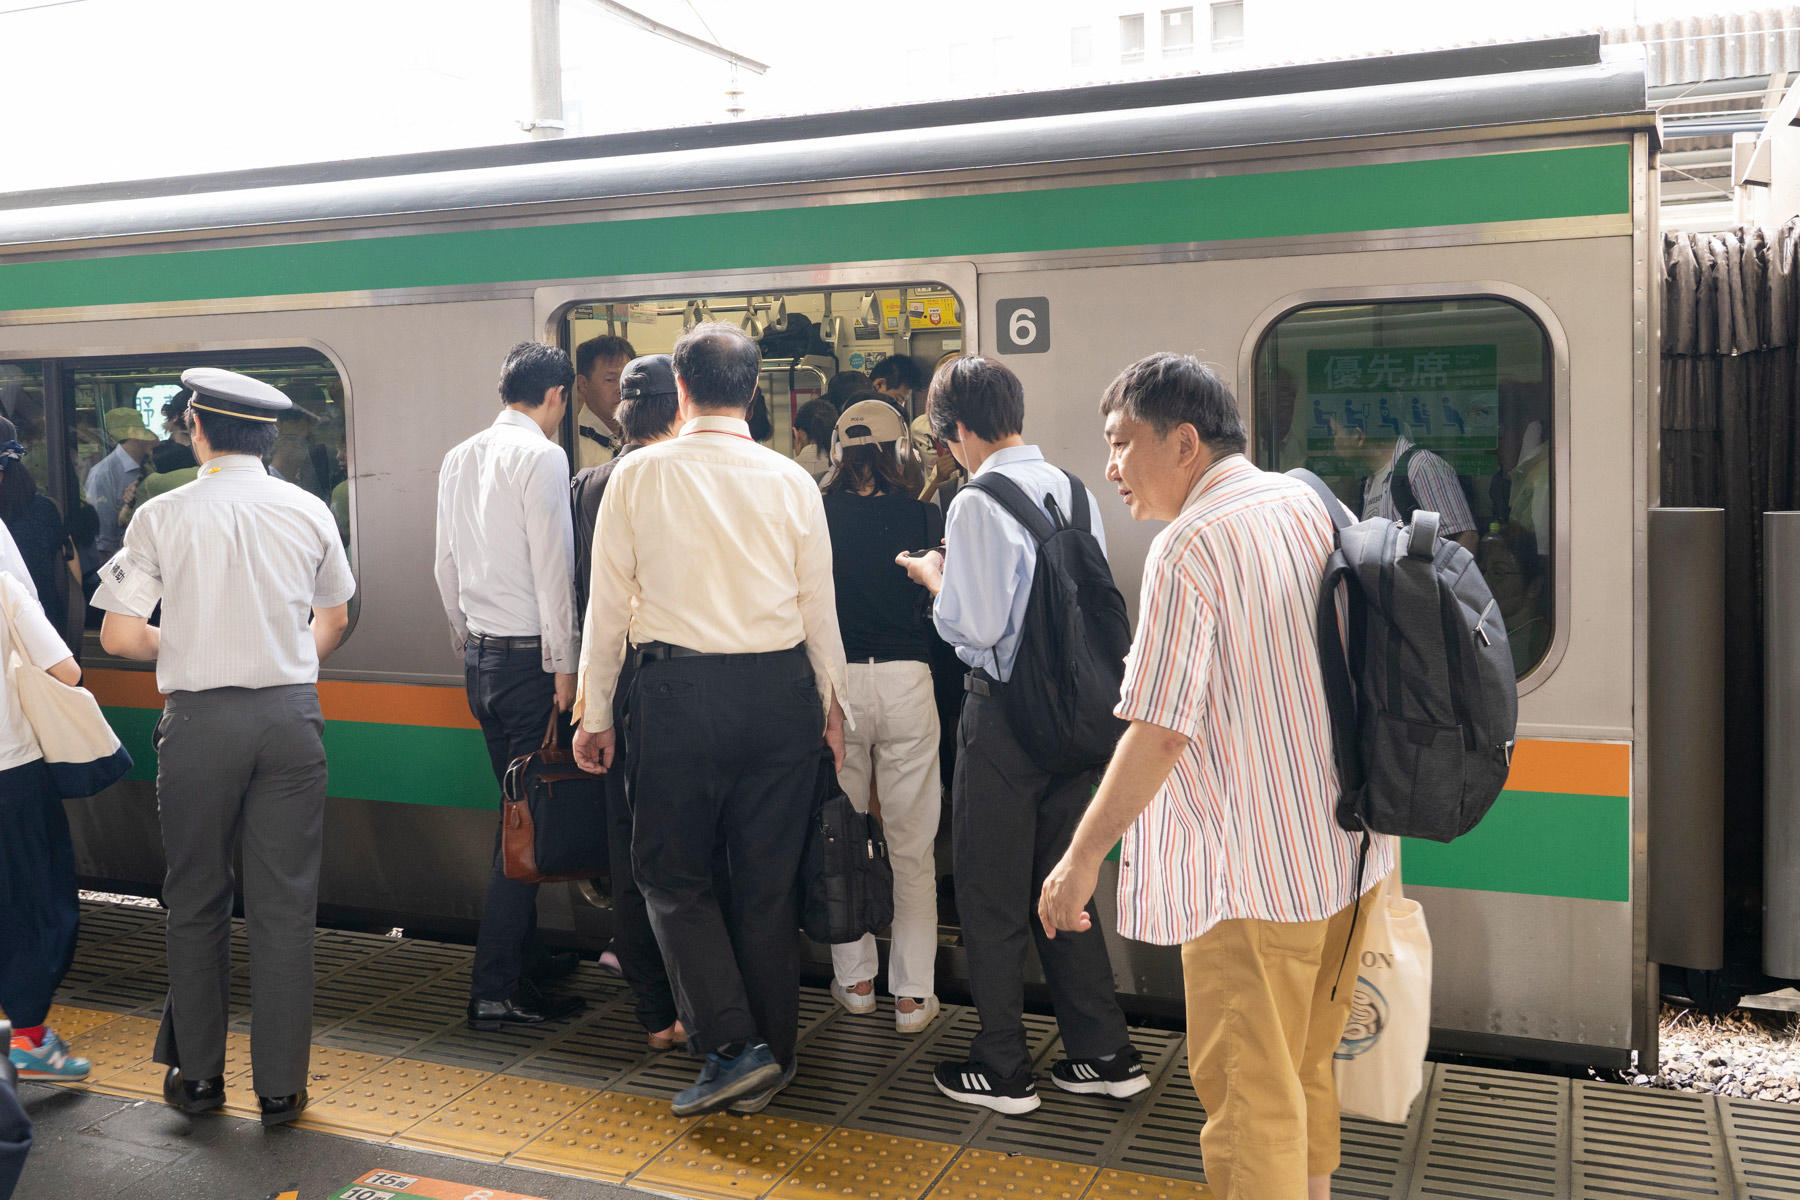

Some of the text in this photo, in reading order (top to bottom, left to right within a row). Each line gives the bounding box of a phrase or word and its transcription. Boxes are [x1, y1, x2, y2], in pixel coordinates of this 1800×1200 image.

[1009, 308, 1036, 345] 6
[1323, 352, 1450, 389] 優先席
